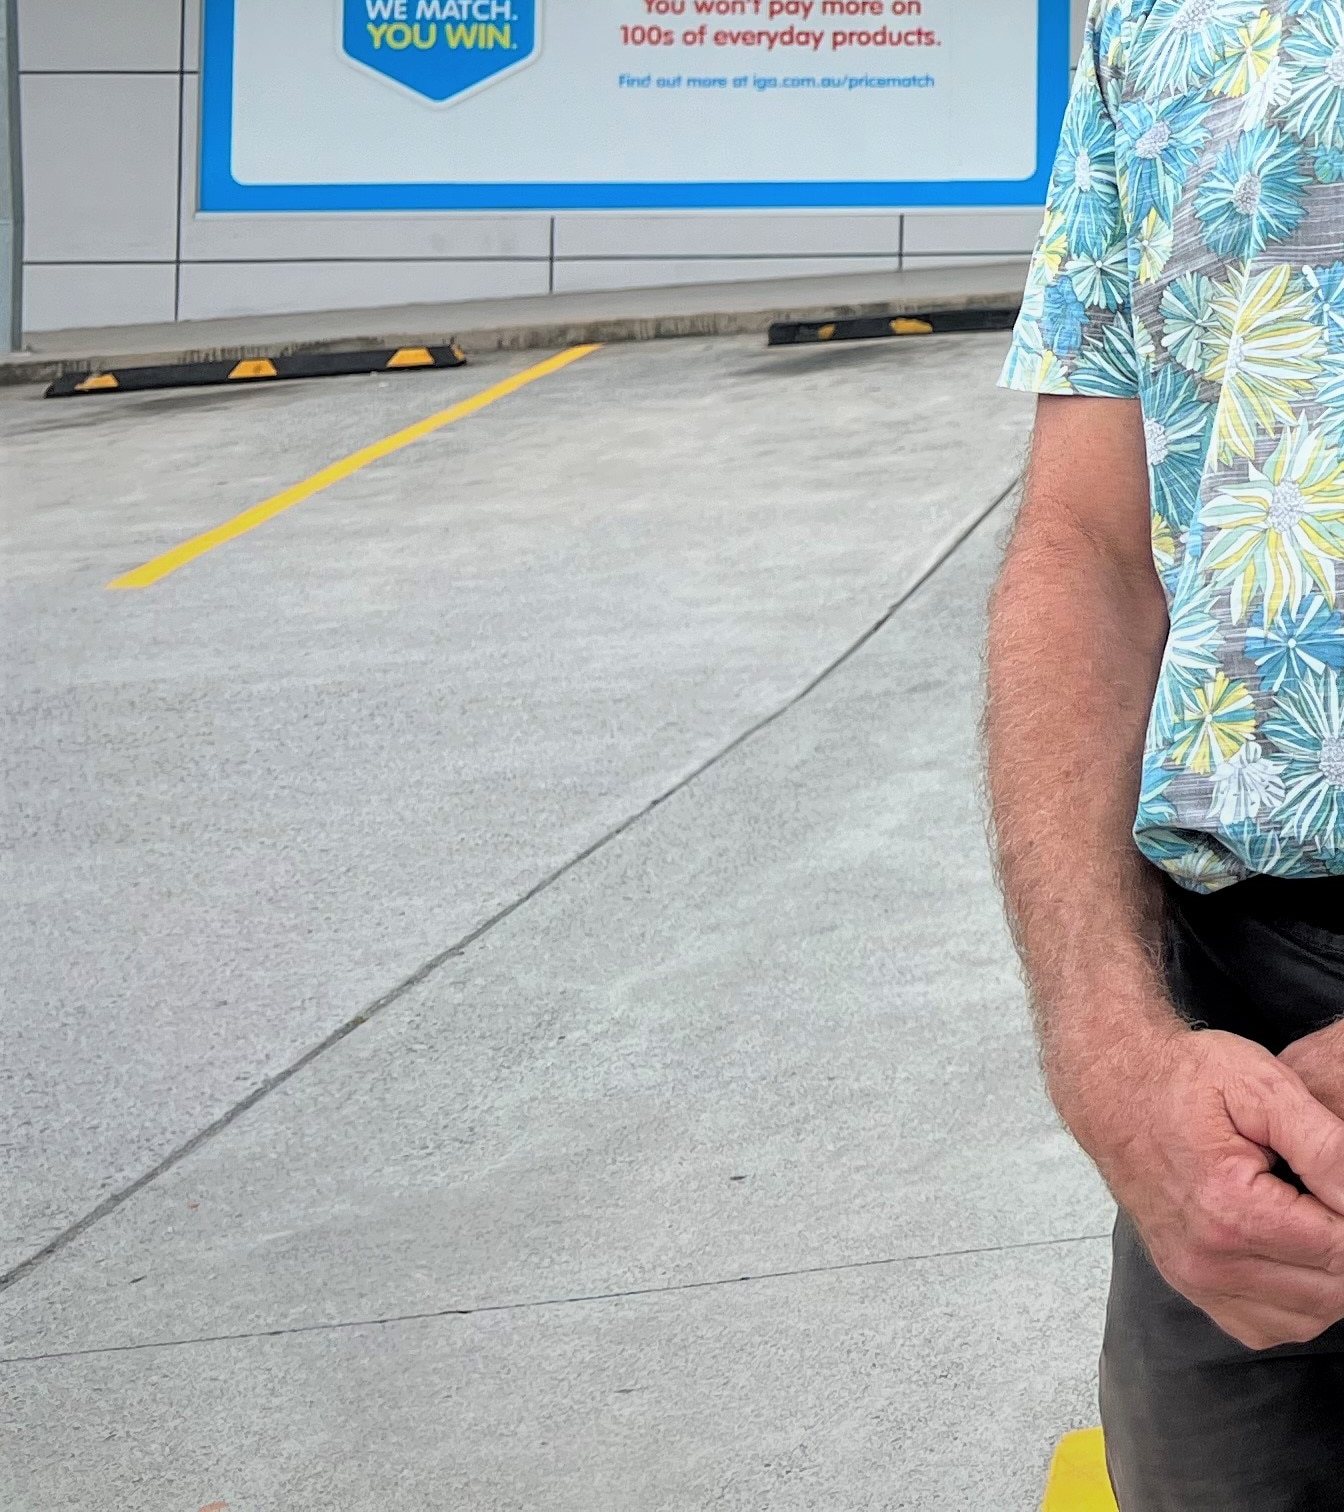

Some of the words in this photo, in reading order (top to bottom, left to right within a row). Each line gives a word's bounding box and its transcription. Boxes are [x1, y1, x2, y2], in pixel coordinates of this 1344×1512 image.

[821, 0, 883, 16] more
[891, 0, 921, 16] on
[366, 23, 437, 49] YOU
[448, 24, 517, 50] WIN.
[619, 25, 675, 46] 100s
[682, 25, 706, 46] of
[713, 27, 824, 51] everyday
[831, 27, 942, 51] products.
[618, 73, 651, 88] Find
[656, 75, 682, 88] out
[687, 76, 727, 88] more
[732, 75, 749, 88] at
